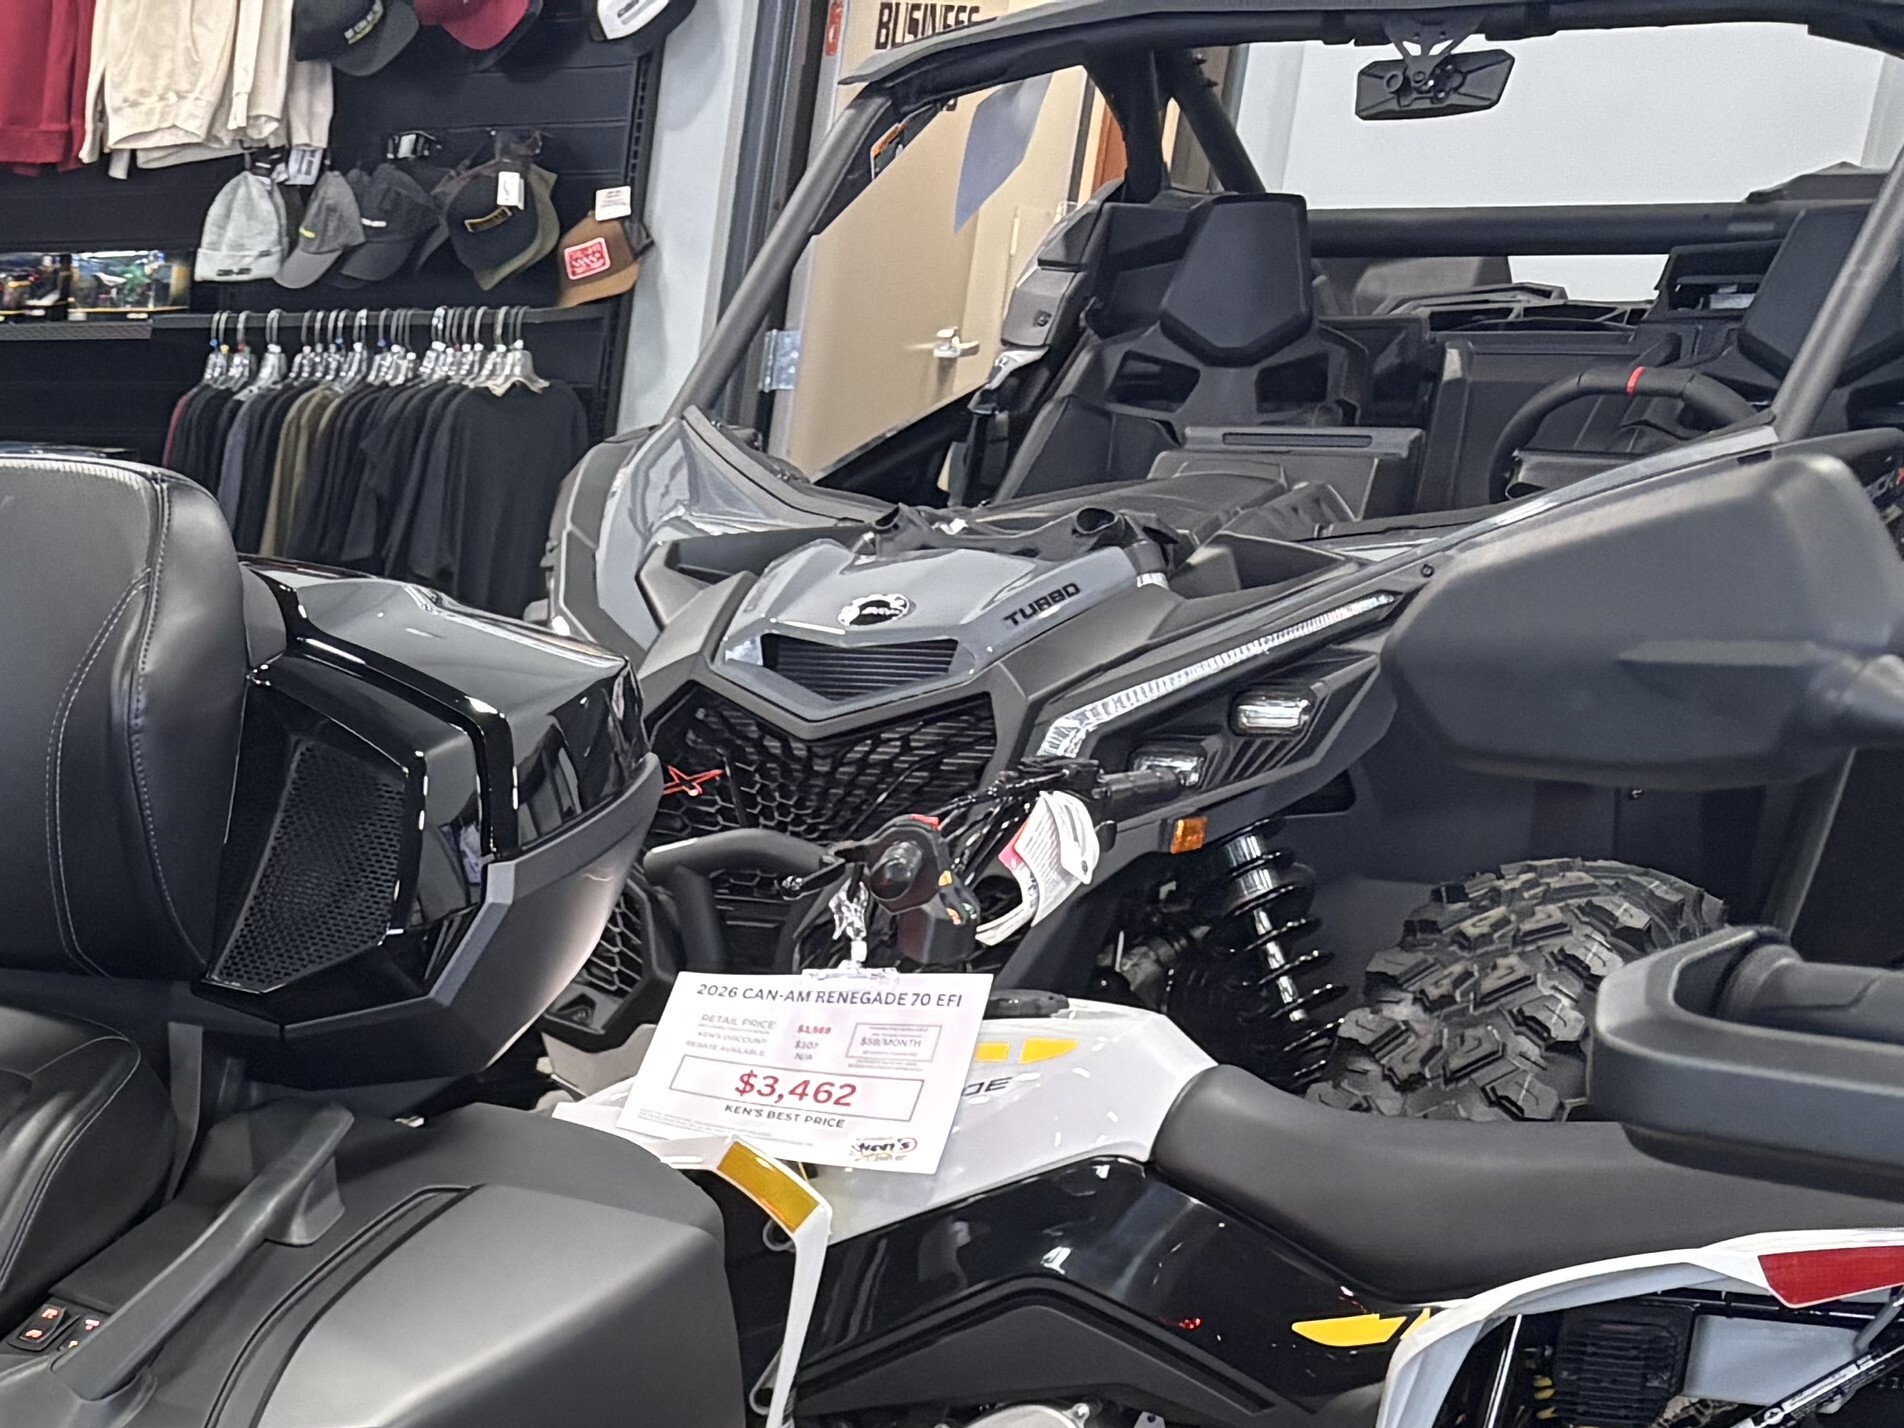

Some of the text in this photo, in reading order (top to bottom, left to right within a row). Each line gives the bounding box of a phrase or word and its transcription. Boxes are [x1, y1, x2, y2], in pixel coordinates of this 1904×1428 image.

[1003, 582, 1081, 626] TURBO
[696, 984, 962, 1008] 2026 CAN-AM RENEGADE 70 EFI
[735, 1070, 857, 1107] $3,462
[724, 1105, 846, 1128] KEN'S BEST PRICE
